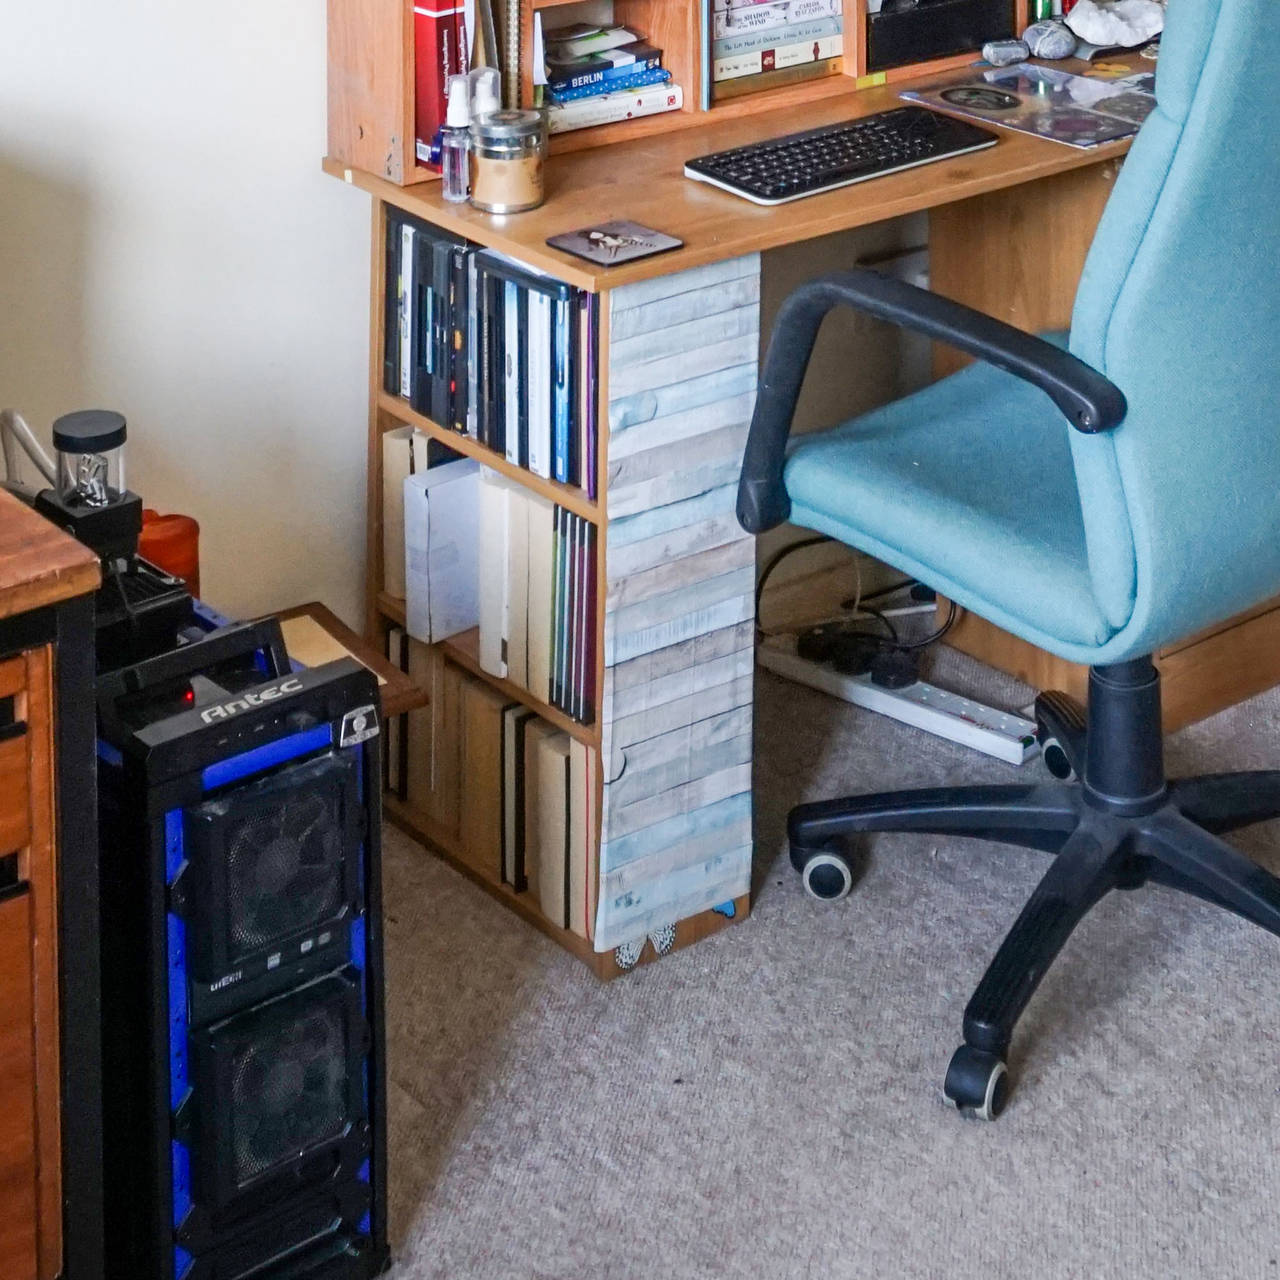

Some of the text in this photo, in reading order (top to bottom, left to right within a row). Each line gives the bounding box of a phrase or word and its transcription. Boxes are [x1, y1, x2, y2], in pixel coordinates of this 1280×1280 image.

[743, 10, 771, 24] SHADOW
[748, 18, 767, 29] WIND
[734, 38, 756, 49] Left Hand
[571, 71, 605, 88] BERLIN
[200, 676, 304, 726] Antec
